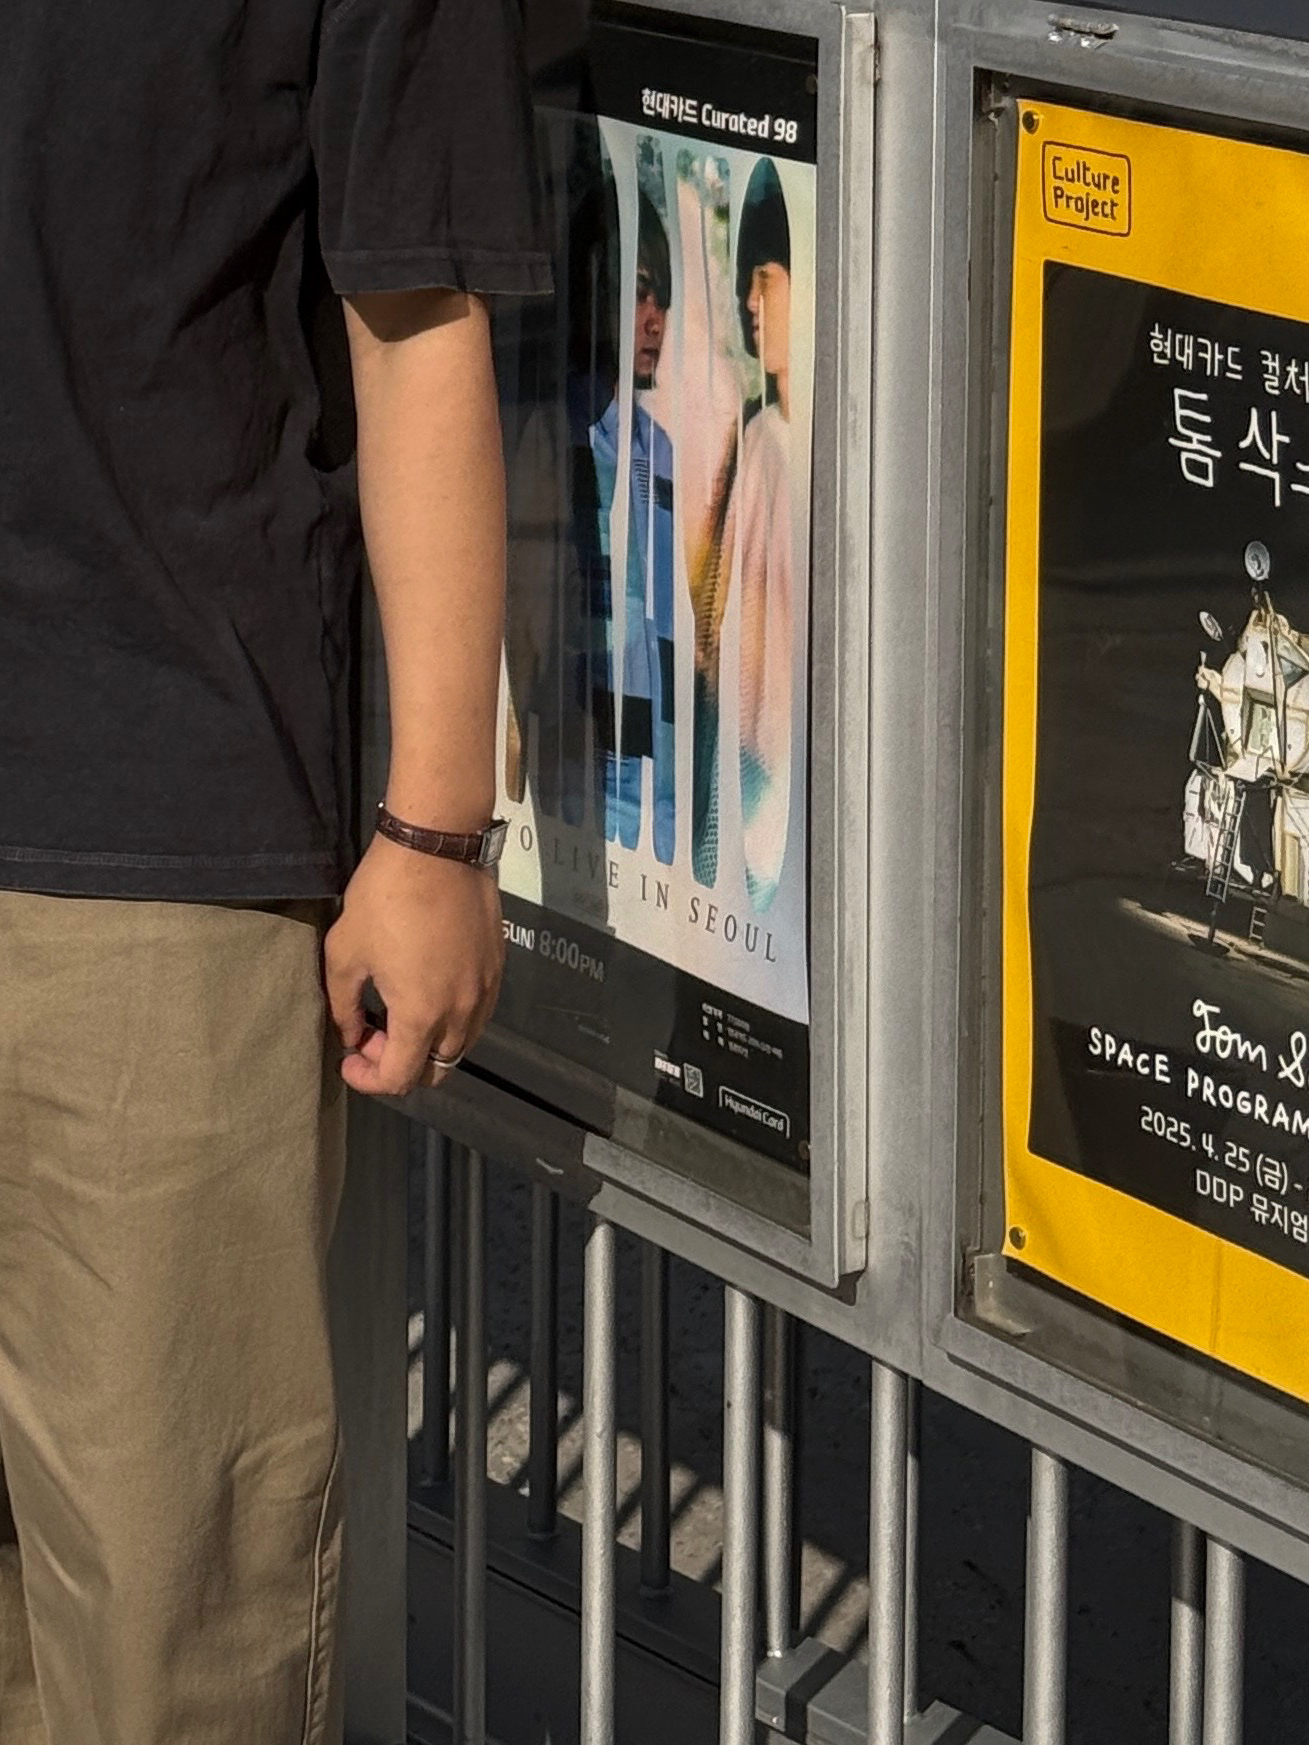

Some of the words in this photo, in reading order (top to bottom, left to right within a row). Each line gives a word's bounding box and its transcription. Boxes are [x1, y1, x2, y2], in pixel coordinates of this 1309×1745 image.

[641, 87, 699, 124] 현대카드
[701, 103, 769, 139] Curated
[773, 118, 798, 144] 98
[1052, 156, 1120, 195] Culture
[1052, 186, 1120, 223] Project
[1149, 322, 1242, 381] 현대카드
[1168, 387, 1222, 487] 톰
[553, 837, 620, 889] LIVE
[640, 873, 670, 910] IN
[688, 896, 777, 963] SEOUL
[539, 929, 606, 983] 8:00PM
[1088, 1027, 1172, 1085] SPACE
[1193, 998, 1268, 1073] Tom
[724, 1093, 762, 1123] Hyundai
[762, 1111, 785, 1132] Card
[1195, 1167, 1245, 1207] DDP
